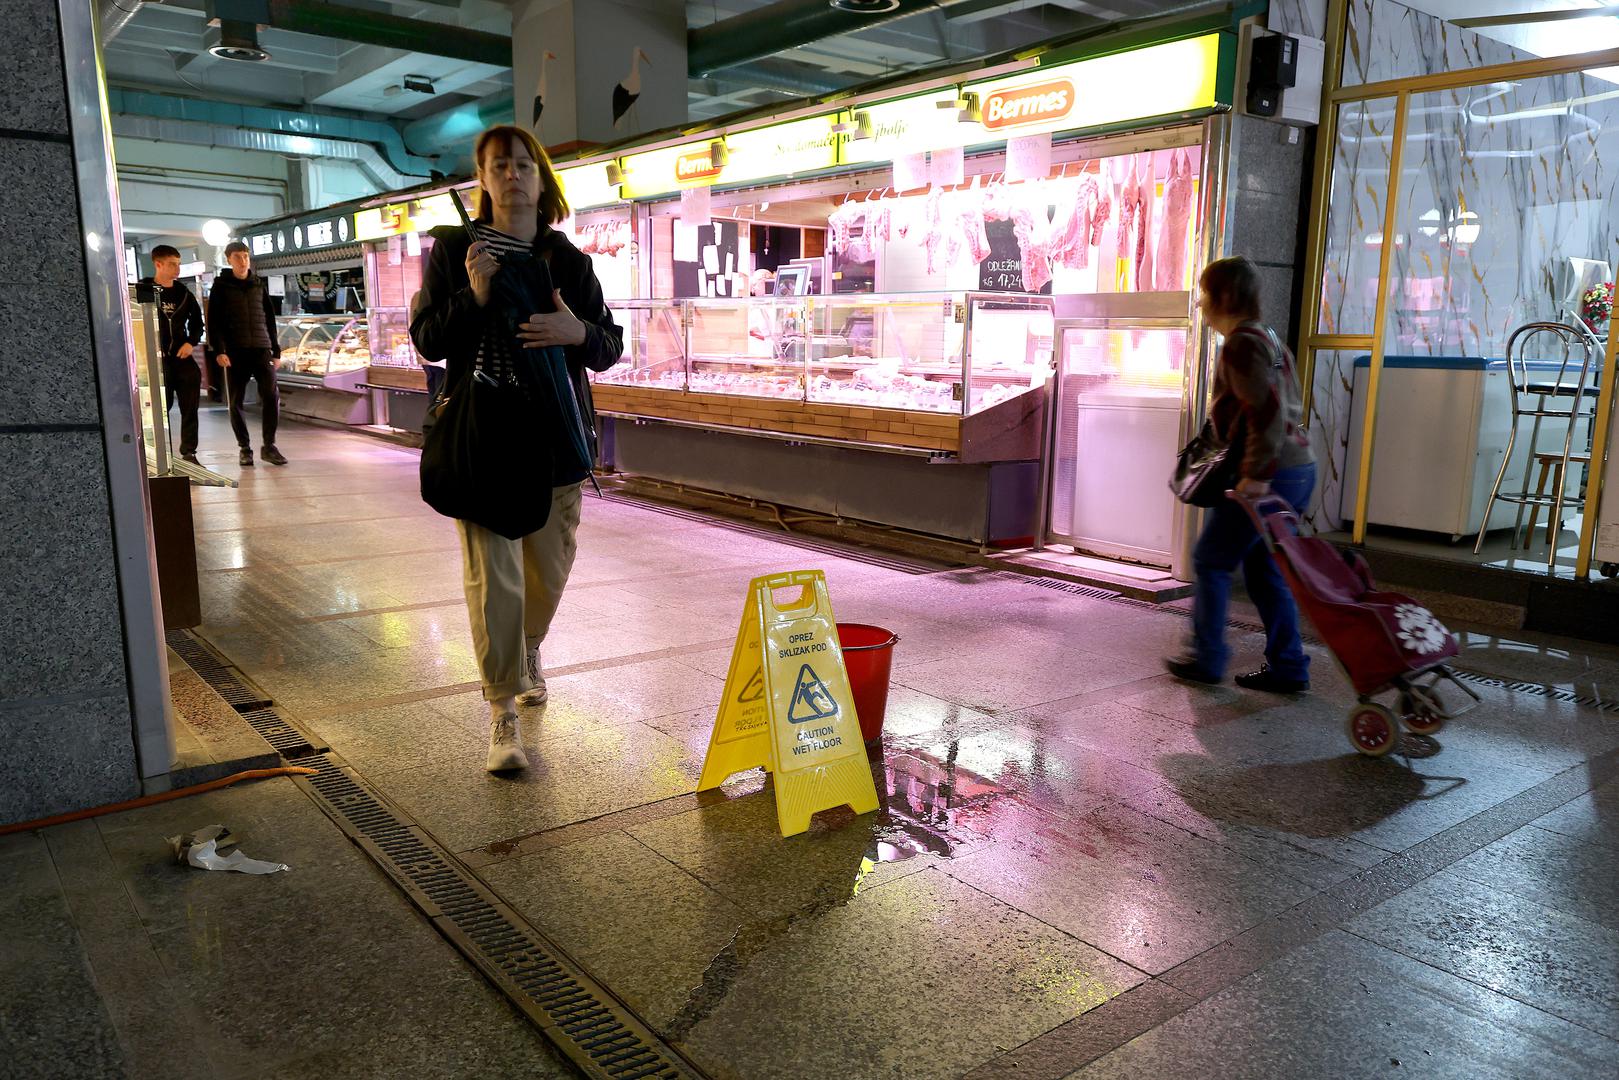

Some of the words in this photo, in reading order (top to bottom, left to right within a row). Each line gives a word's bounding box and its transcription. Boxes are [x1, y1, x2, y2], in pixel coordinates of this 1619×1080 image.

[988, 90, 1067, 121] Bermes
[679, 156, 713, 175] Berm
[789, 632, 814, 643] OPREZ
[779, 646, 810, 658] SKLIZAK
[812, 643, 827, 653] POD
[797, 726, 834, 741] CAUTION
[792, 745, 812, 755] WET
[813, 737, 842, 751] FLOOR
